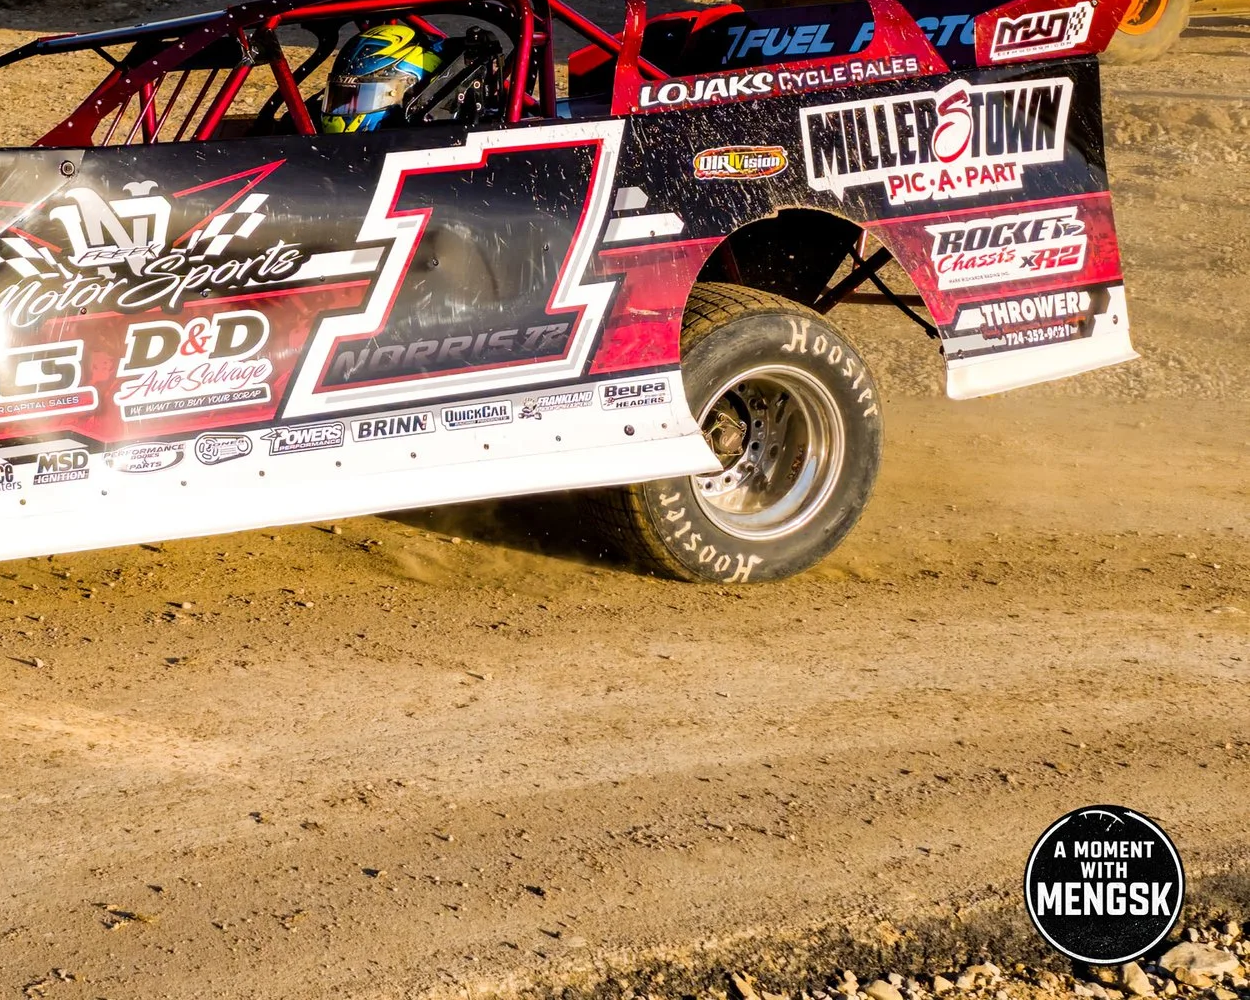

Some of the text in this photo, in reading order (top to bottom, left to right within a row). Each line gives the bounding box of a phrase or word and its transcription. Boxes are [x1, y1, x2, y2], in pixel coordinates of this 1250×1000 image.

[640, 72, 773, 107] LOJAKS
[807, 85, 1063, 179] MILLERSTOWN
[937, 215, 1072, 255] ROCKET
[282, 119, 625, 418] 1
[937, 246, 1015, 273] Chassis
[119, 240, 303, 308] Sports
[981, 292, 1079, 327] THROWER
[124, 315, 265, 371] D&D
[332, 329, 519, 376] NORRIS
[120, 361, 266, 400] Auto Salvage
[782, 318, 878, 418] Hoosier
[7, 402, 46, 413] CAPITAL
[49, 397, 79, 407] SALES
[130, 390, 261, 415] WE WANT TO BUY YOUR SCRAP
[537, 391, 593, 407] FRANKLAND
[604, 382, 665, 401] Beyea
[616, 397, 664, 408] HEADERS
[274, 424, 342, 451] POWERS
[358, 414, 427, 439] BRINN
[103, 443, 185, 458] PERFORMANCE
[279, 439, 341, 450] PERFORMANCE
[38, 451, 89, 473] MSD
[129, 461, 162, 470] PARTS
[659, 492, 763, 583] Hoosier
